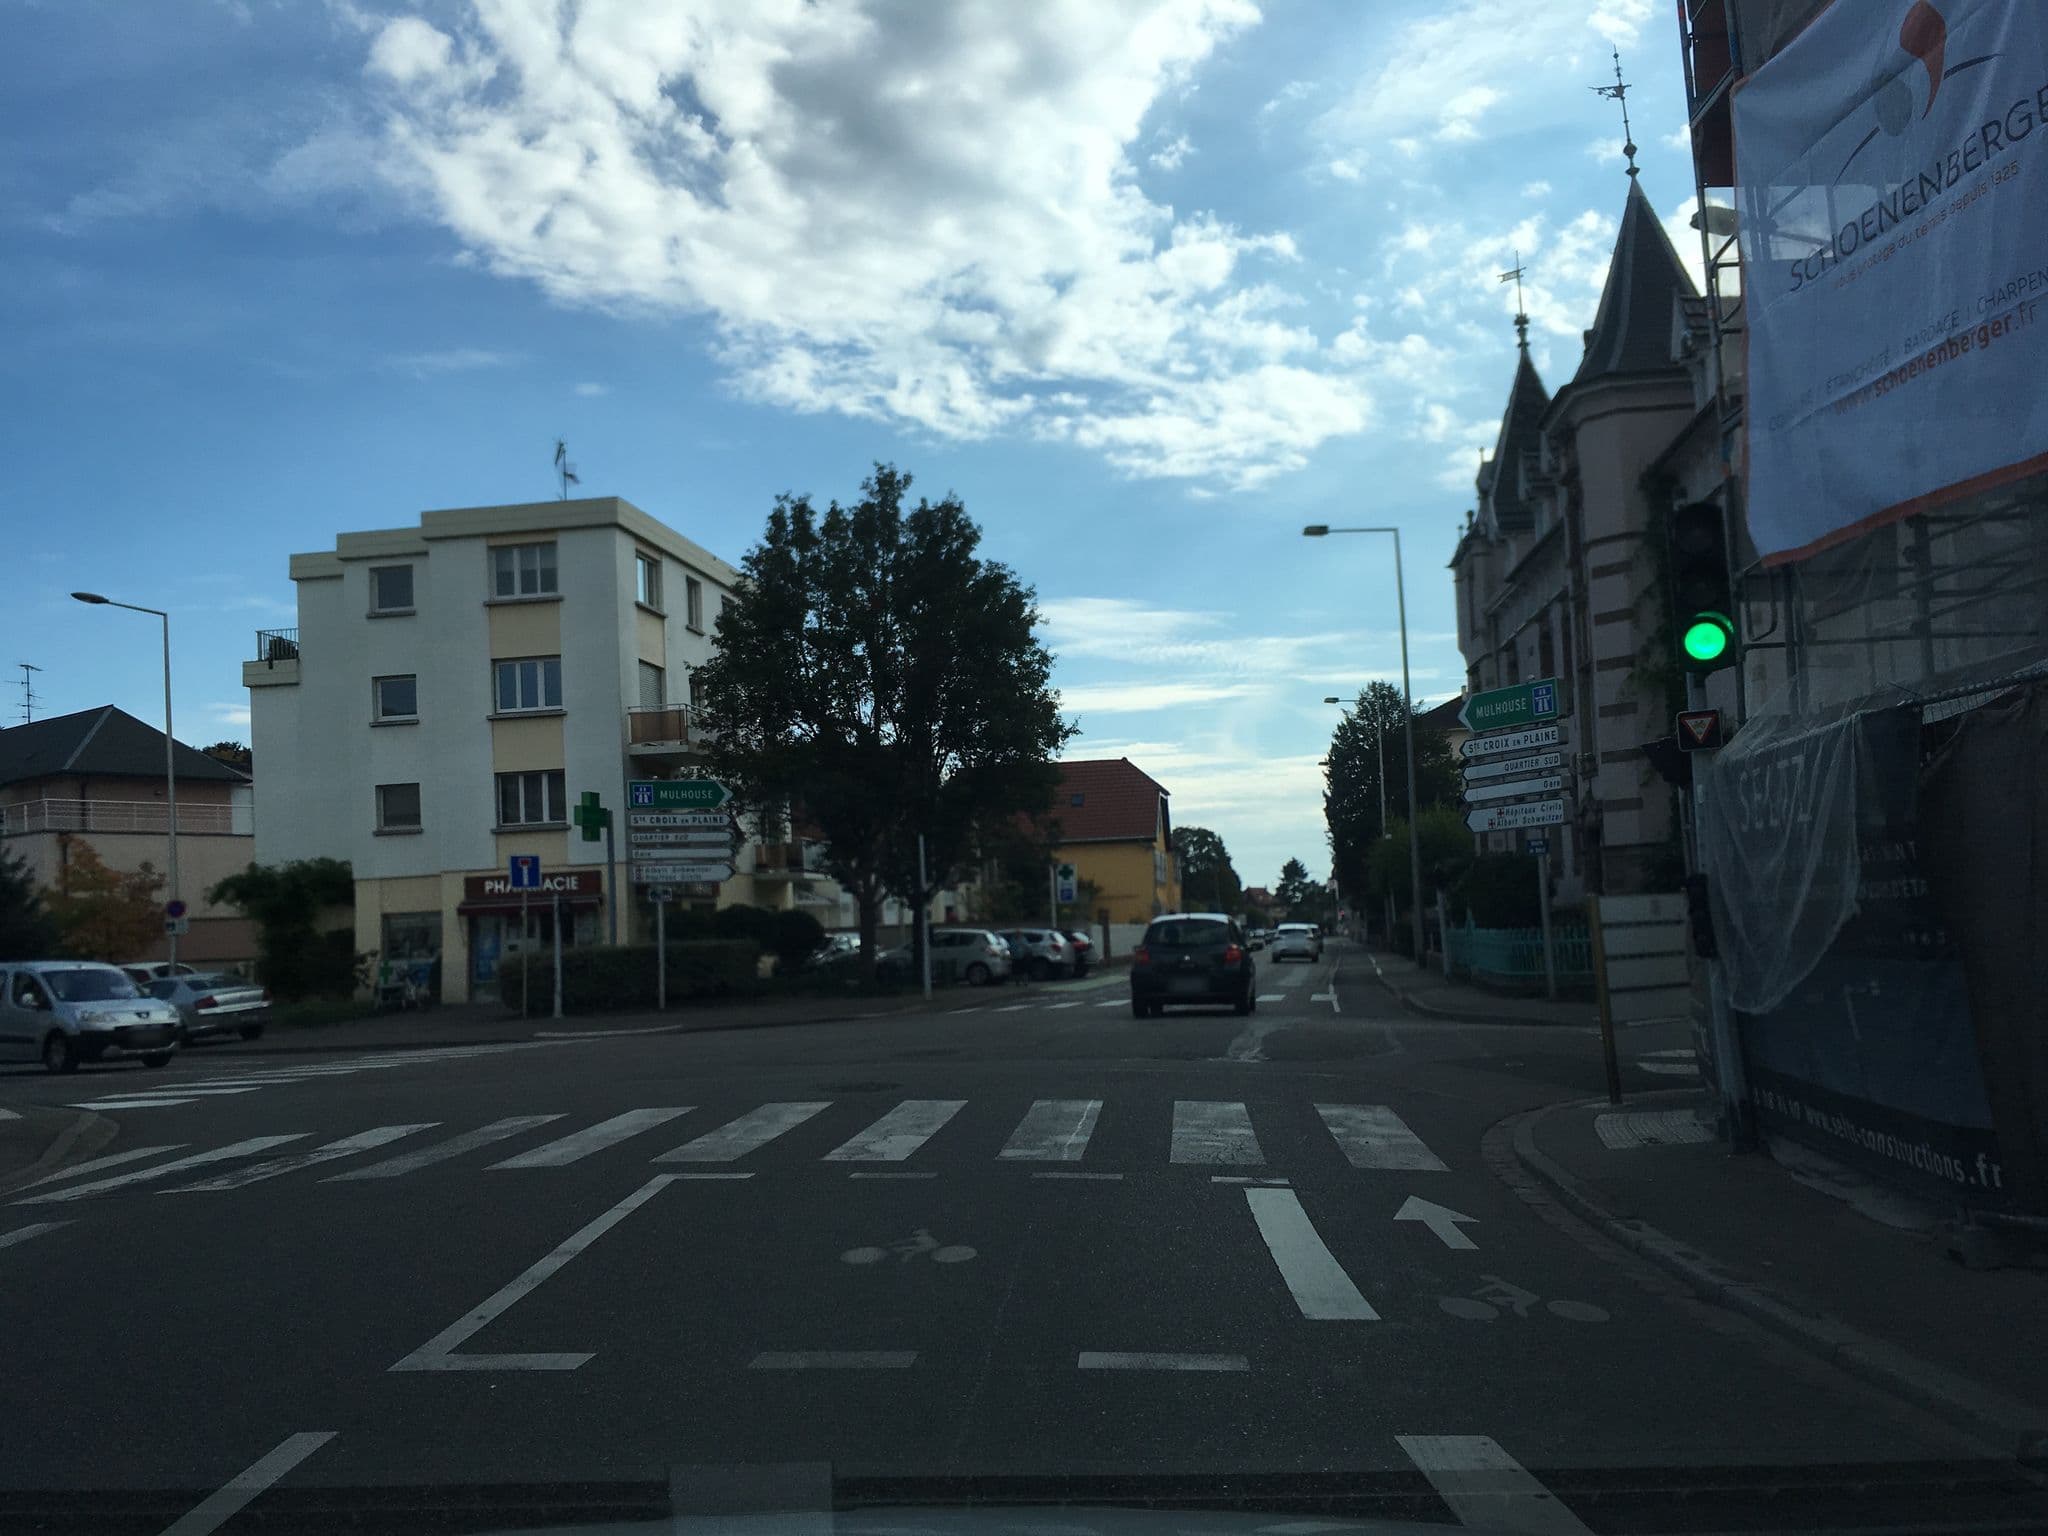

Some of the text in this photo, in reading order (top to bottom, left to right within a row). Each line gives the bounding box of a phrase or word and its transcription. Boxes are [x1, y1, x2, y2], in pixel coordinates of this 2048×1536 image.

[1476, 697, 1527, 719] MULHOUSE
[1483, 737, 1510, 751] CROIX
[1523, 730, 1557, 745] PLAINE
[1504, 755, 1559, 772] QUARTIER SUD
[1543, 778, 1560, 788] Gare
[659, 790, 713, 799] MULHOUSE
[649, 816, 678, 824] CROIX
[692, 816, 724, 824] PLAINE
[484, 876, 579, 895] PHACIE
